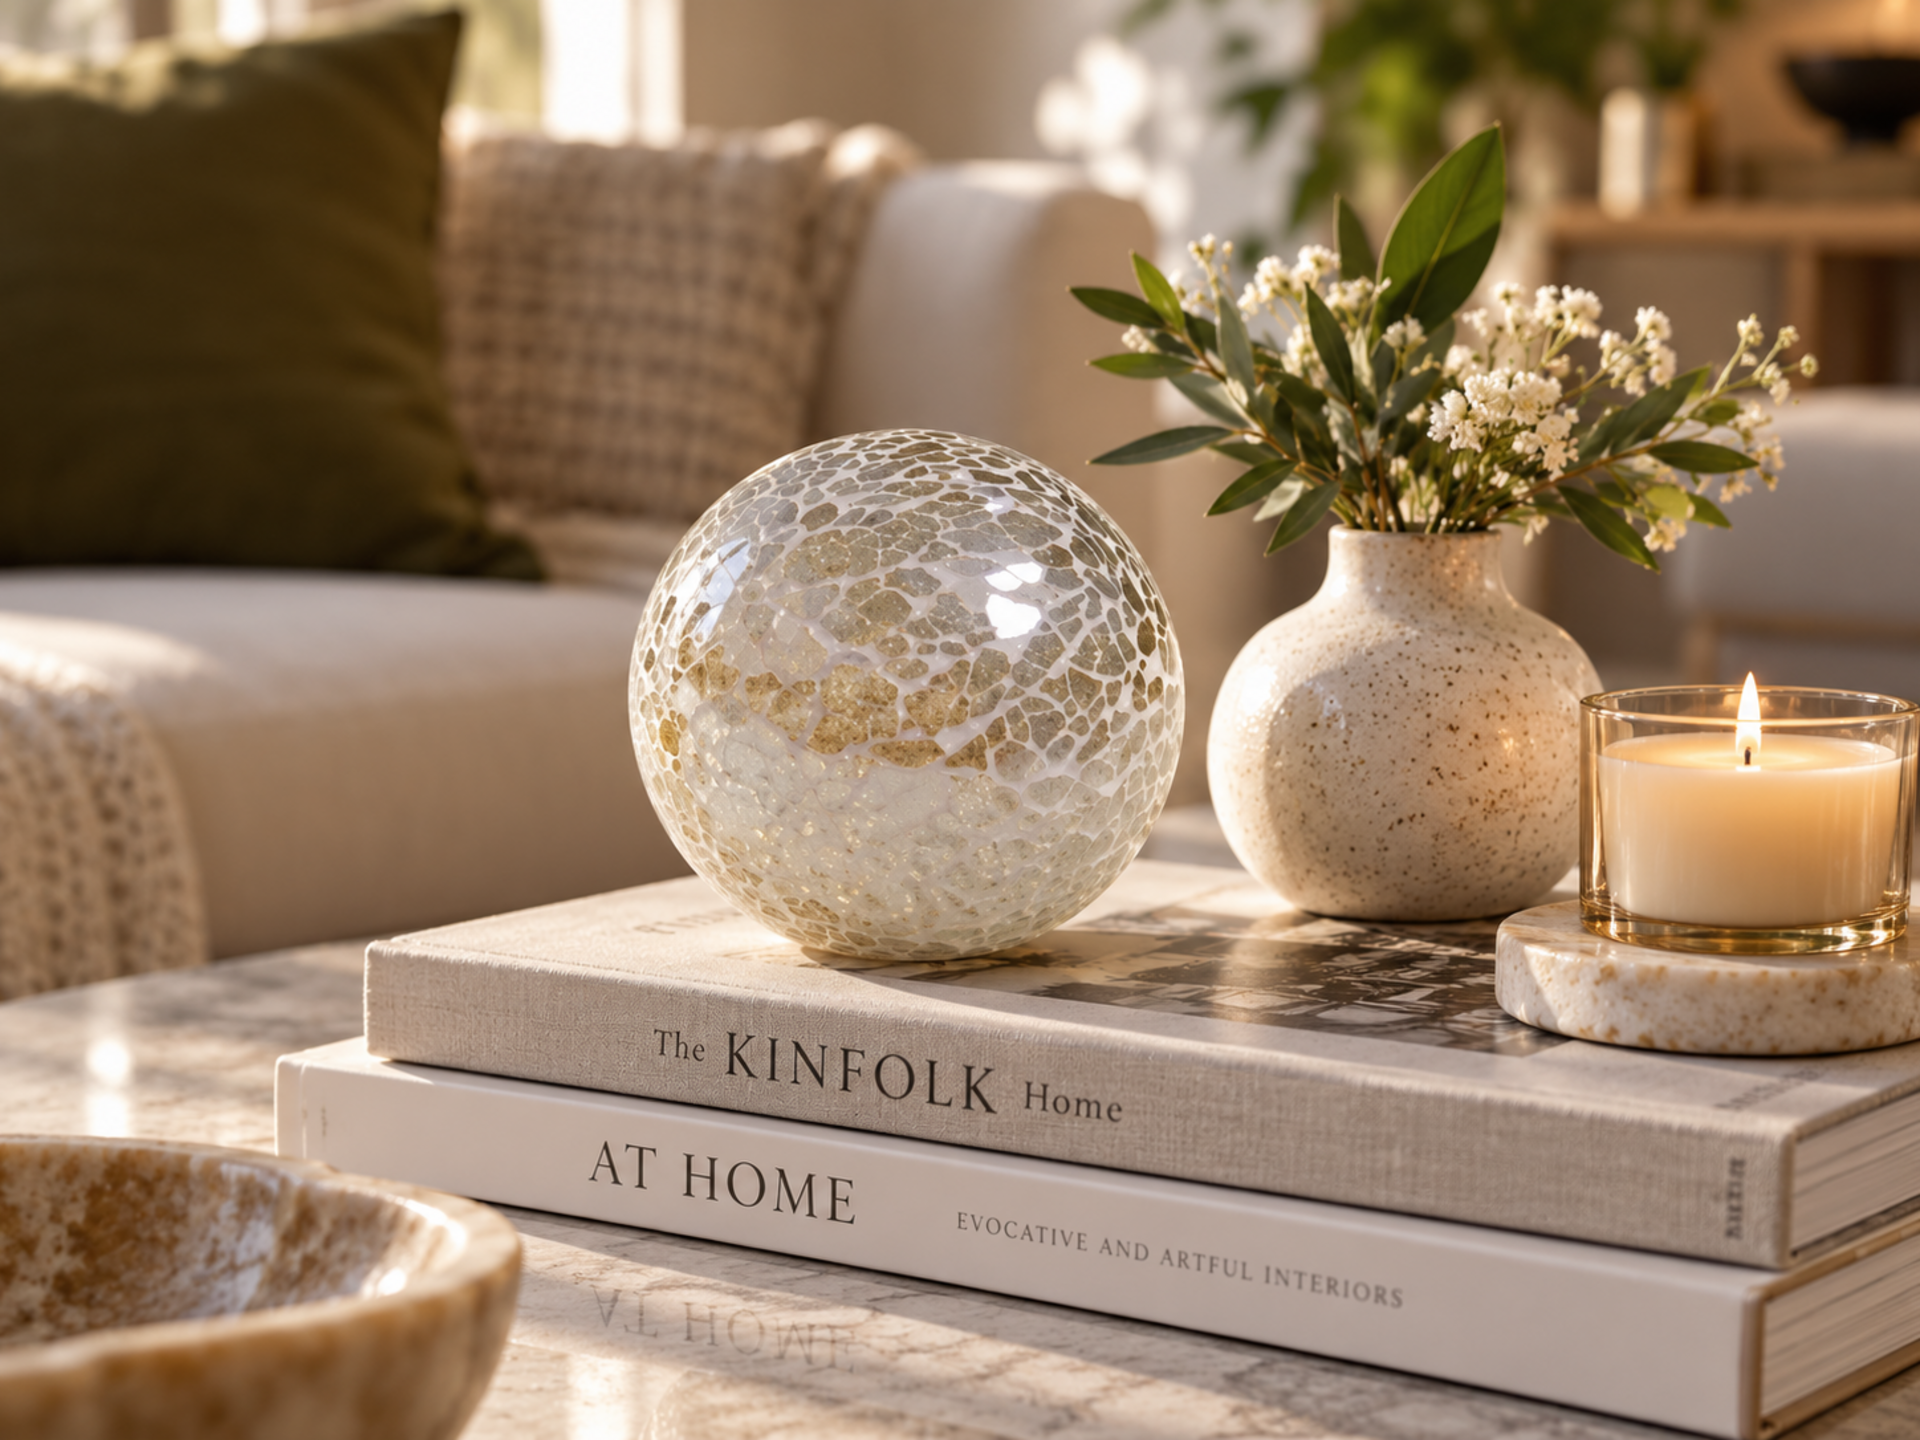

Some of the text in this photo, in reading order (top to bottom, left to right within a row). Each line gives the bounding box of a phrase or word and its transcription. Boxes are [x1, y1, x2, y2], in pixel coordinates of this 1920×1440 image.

[653, 1028, 1124, 1124] The KINFOLK Home
[587, 1139, 857, 1226] AT HOME
[956, 1210, 1405, 1310] EVOCATIVE AND ARTFUL INTERIORS
